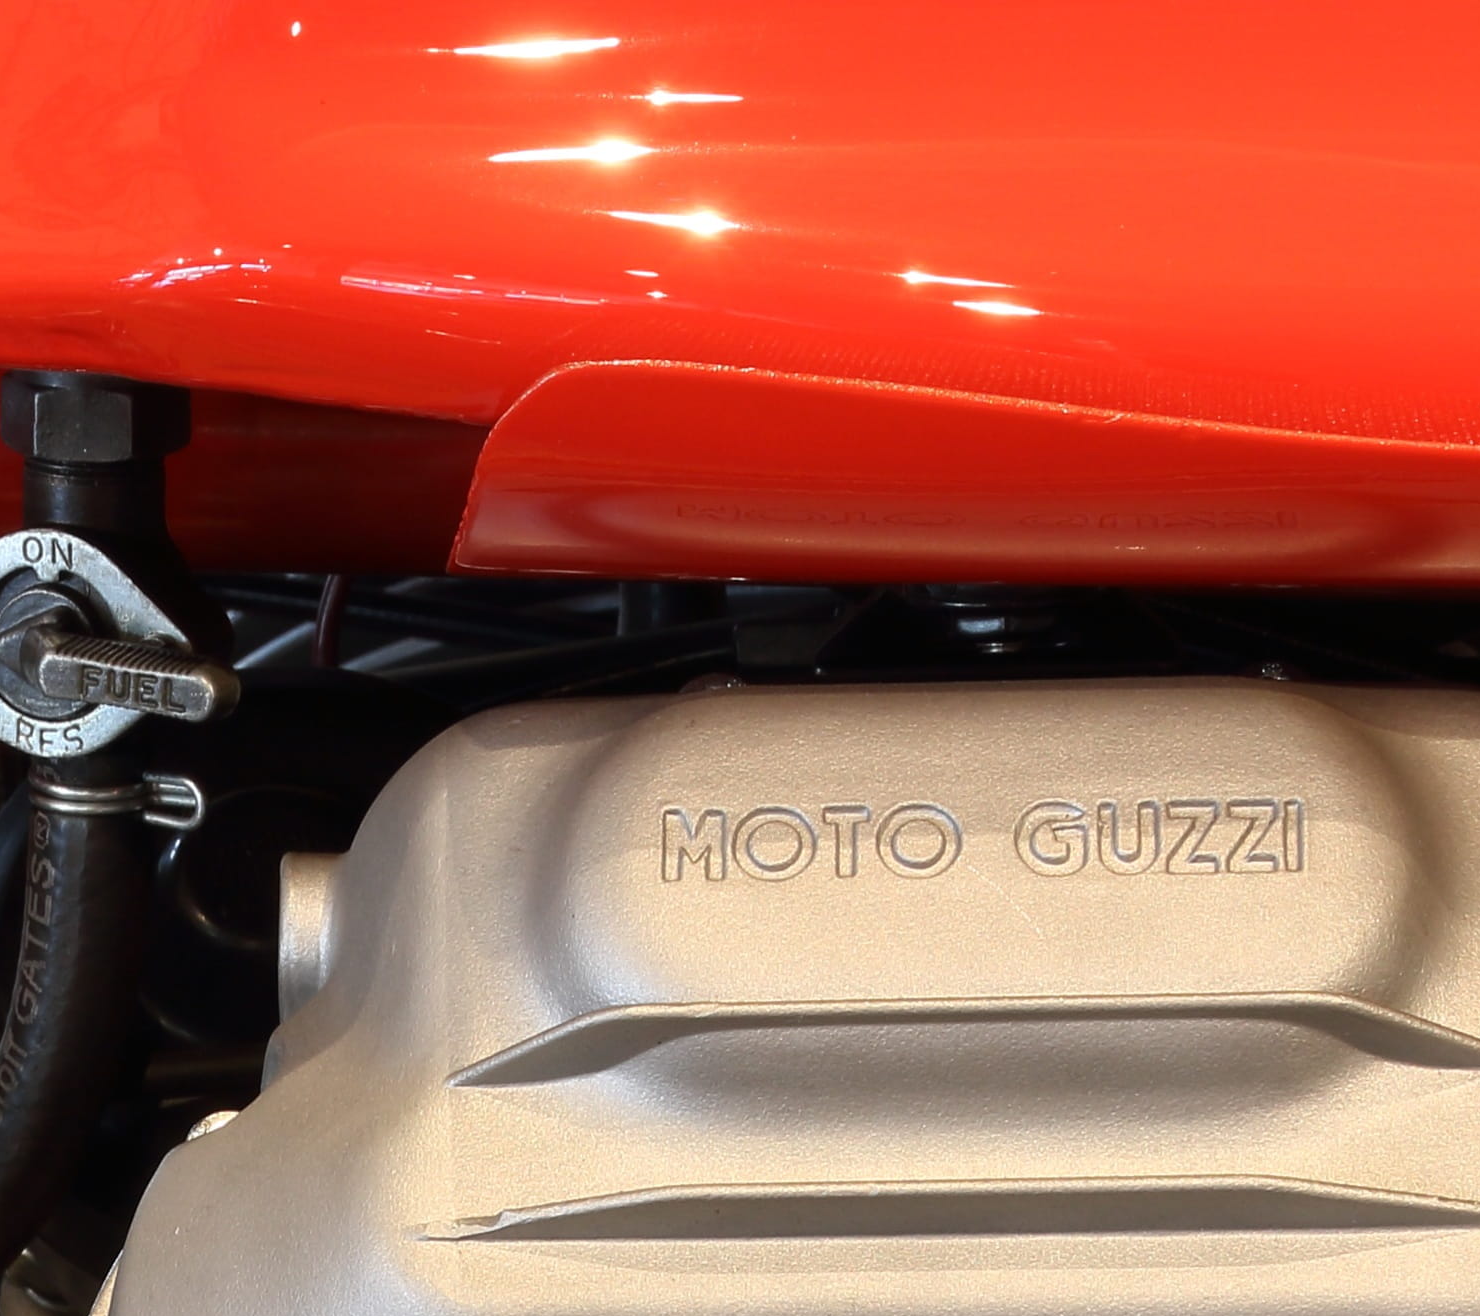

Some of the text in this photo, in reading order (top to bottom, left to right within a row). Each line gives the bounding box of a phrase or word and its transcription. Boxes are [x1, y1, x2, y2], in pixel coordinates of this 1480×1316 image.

[22, 536, 74, 569] ON
[80, 665, 187, 714] FUEL
[660, 798, 1306, 882] MOTO GUZZI
